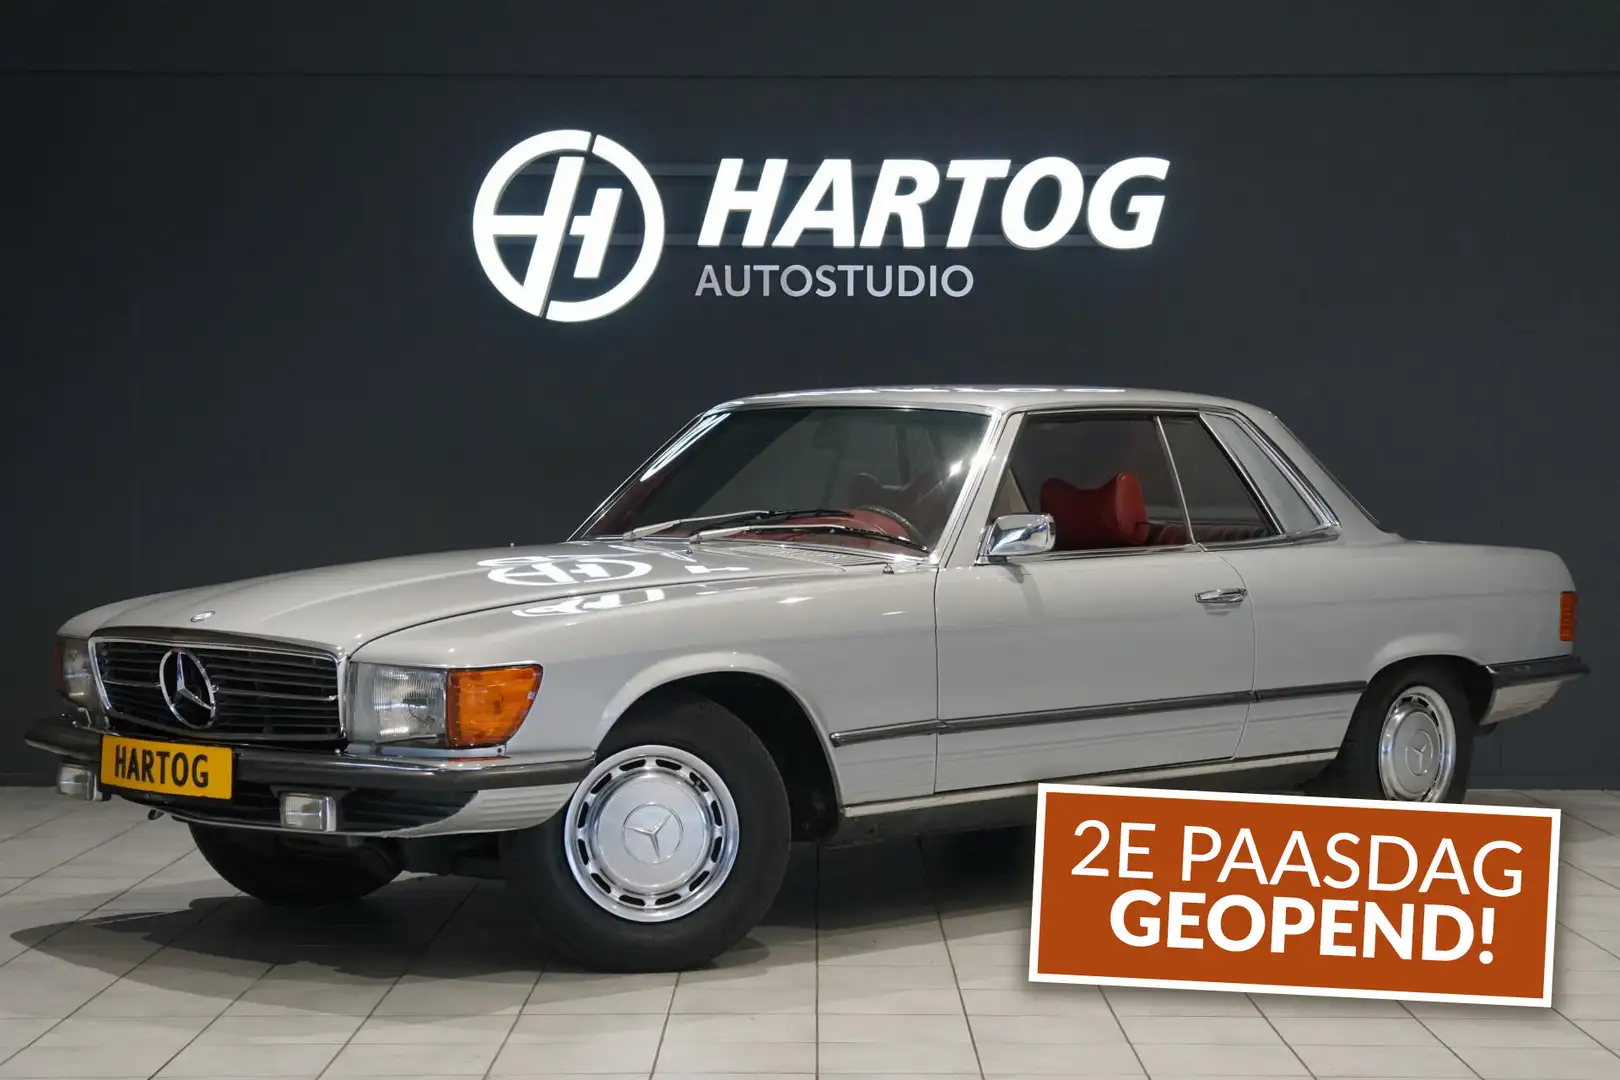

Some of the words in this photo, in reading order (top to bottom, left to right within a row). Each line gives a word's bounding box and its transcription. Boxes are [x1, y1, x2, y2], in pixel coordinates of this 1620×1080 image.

[698, 157, 1171, 249] HARTOG
[695, 264, 974, 298] AUTOSTUDIO
[114, 744, 209, 788] HARTOG
